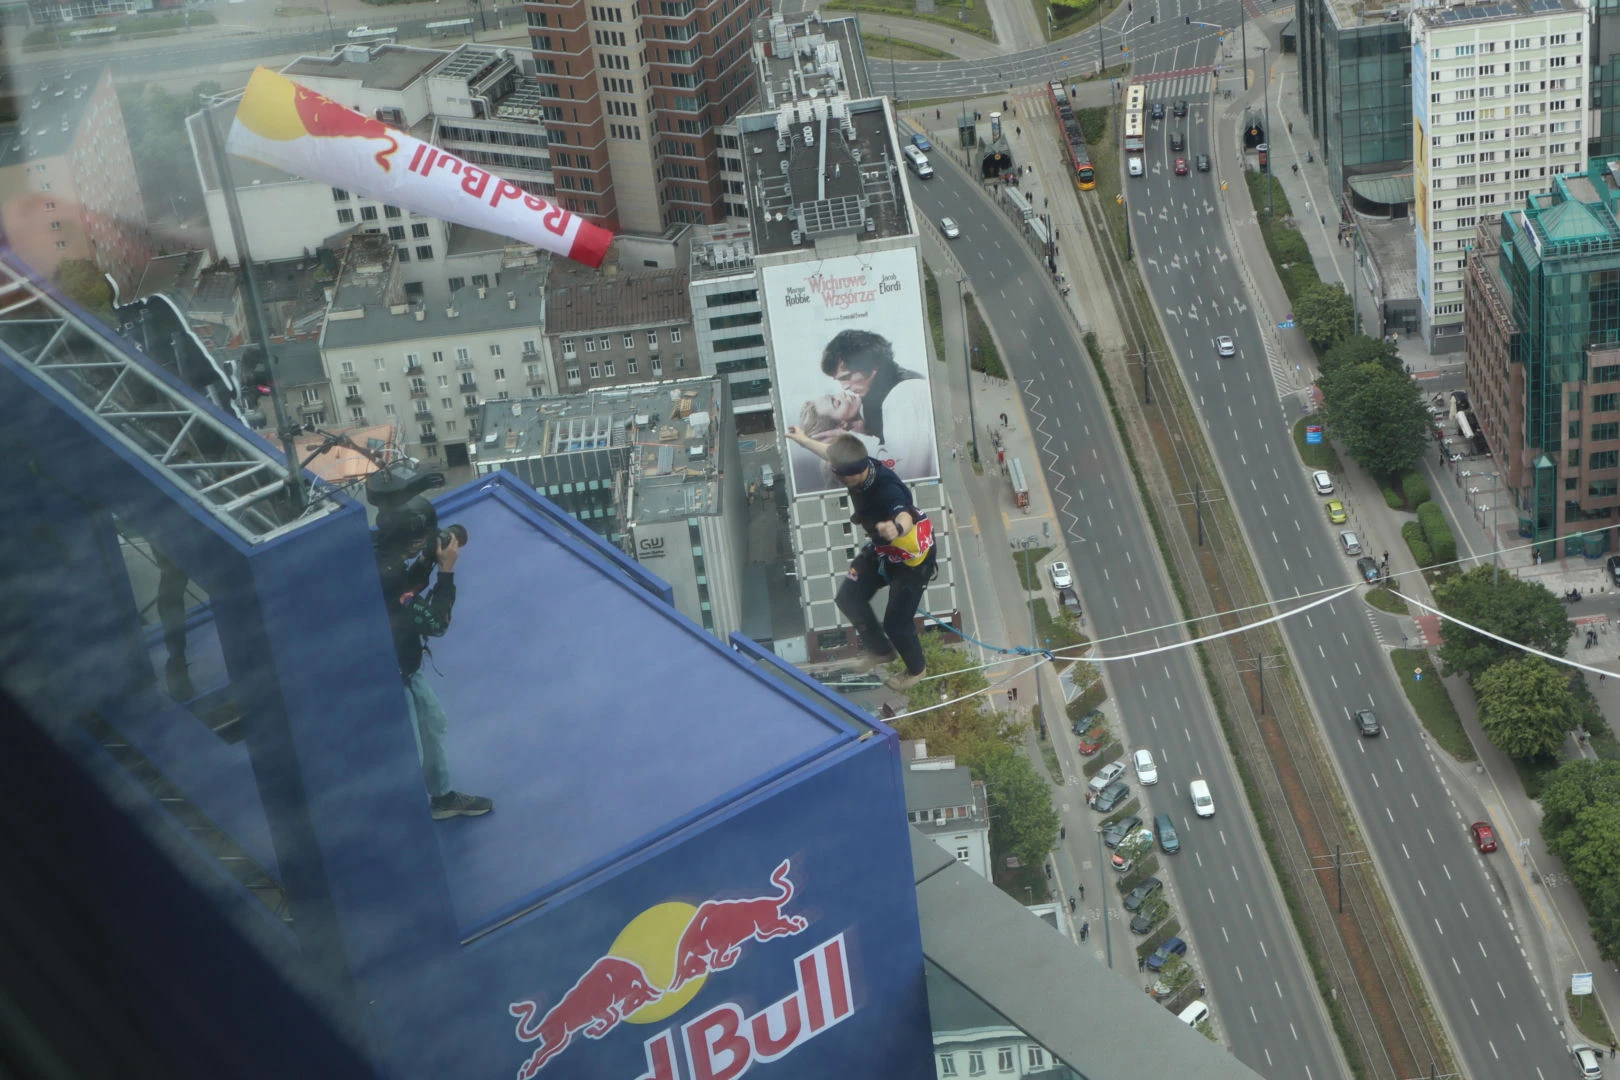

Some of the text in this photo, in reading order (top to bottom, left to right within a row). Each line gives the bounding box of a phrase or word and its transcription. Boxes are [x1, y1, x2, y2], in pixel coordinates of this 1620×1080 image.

[408, 144, 573, 236] Red Bull
[804, 273, 868, 294] Wichrowe
[879, 281, 901, 294] Elordi
[785, 294, 810, 307] Robbie
[821, 289, 877, 310] Wzgórza
[682, 934, 854, 1080] Bull
